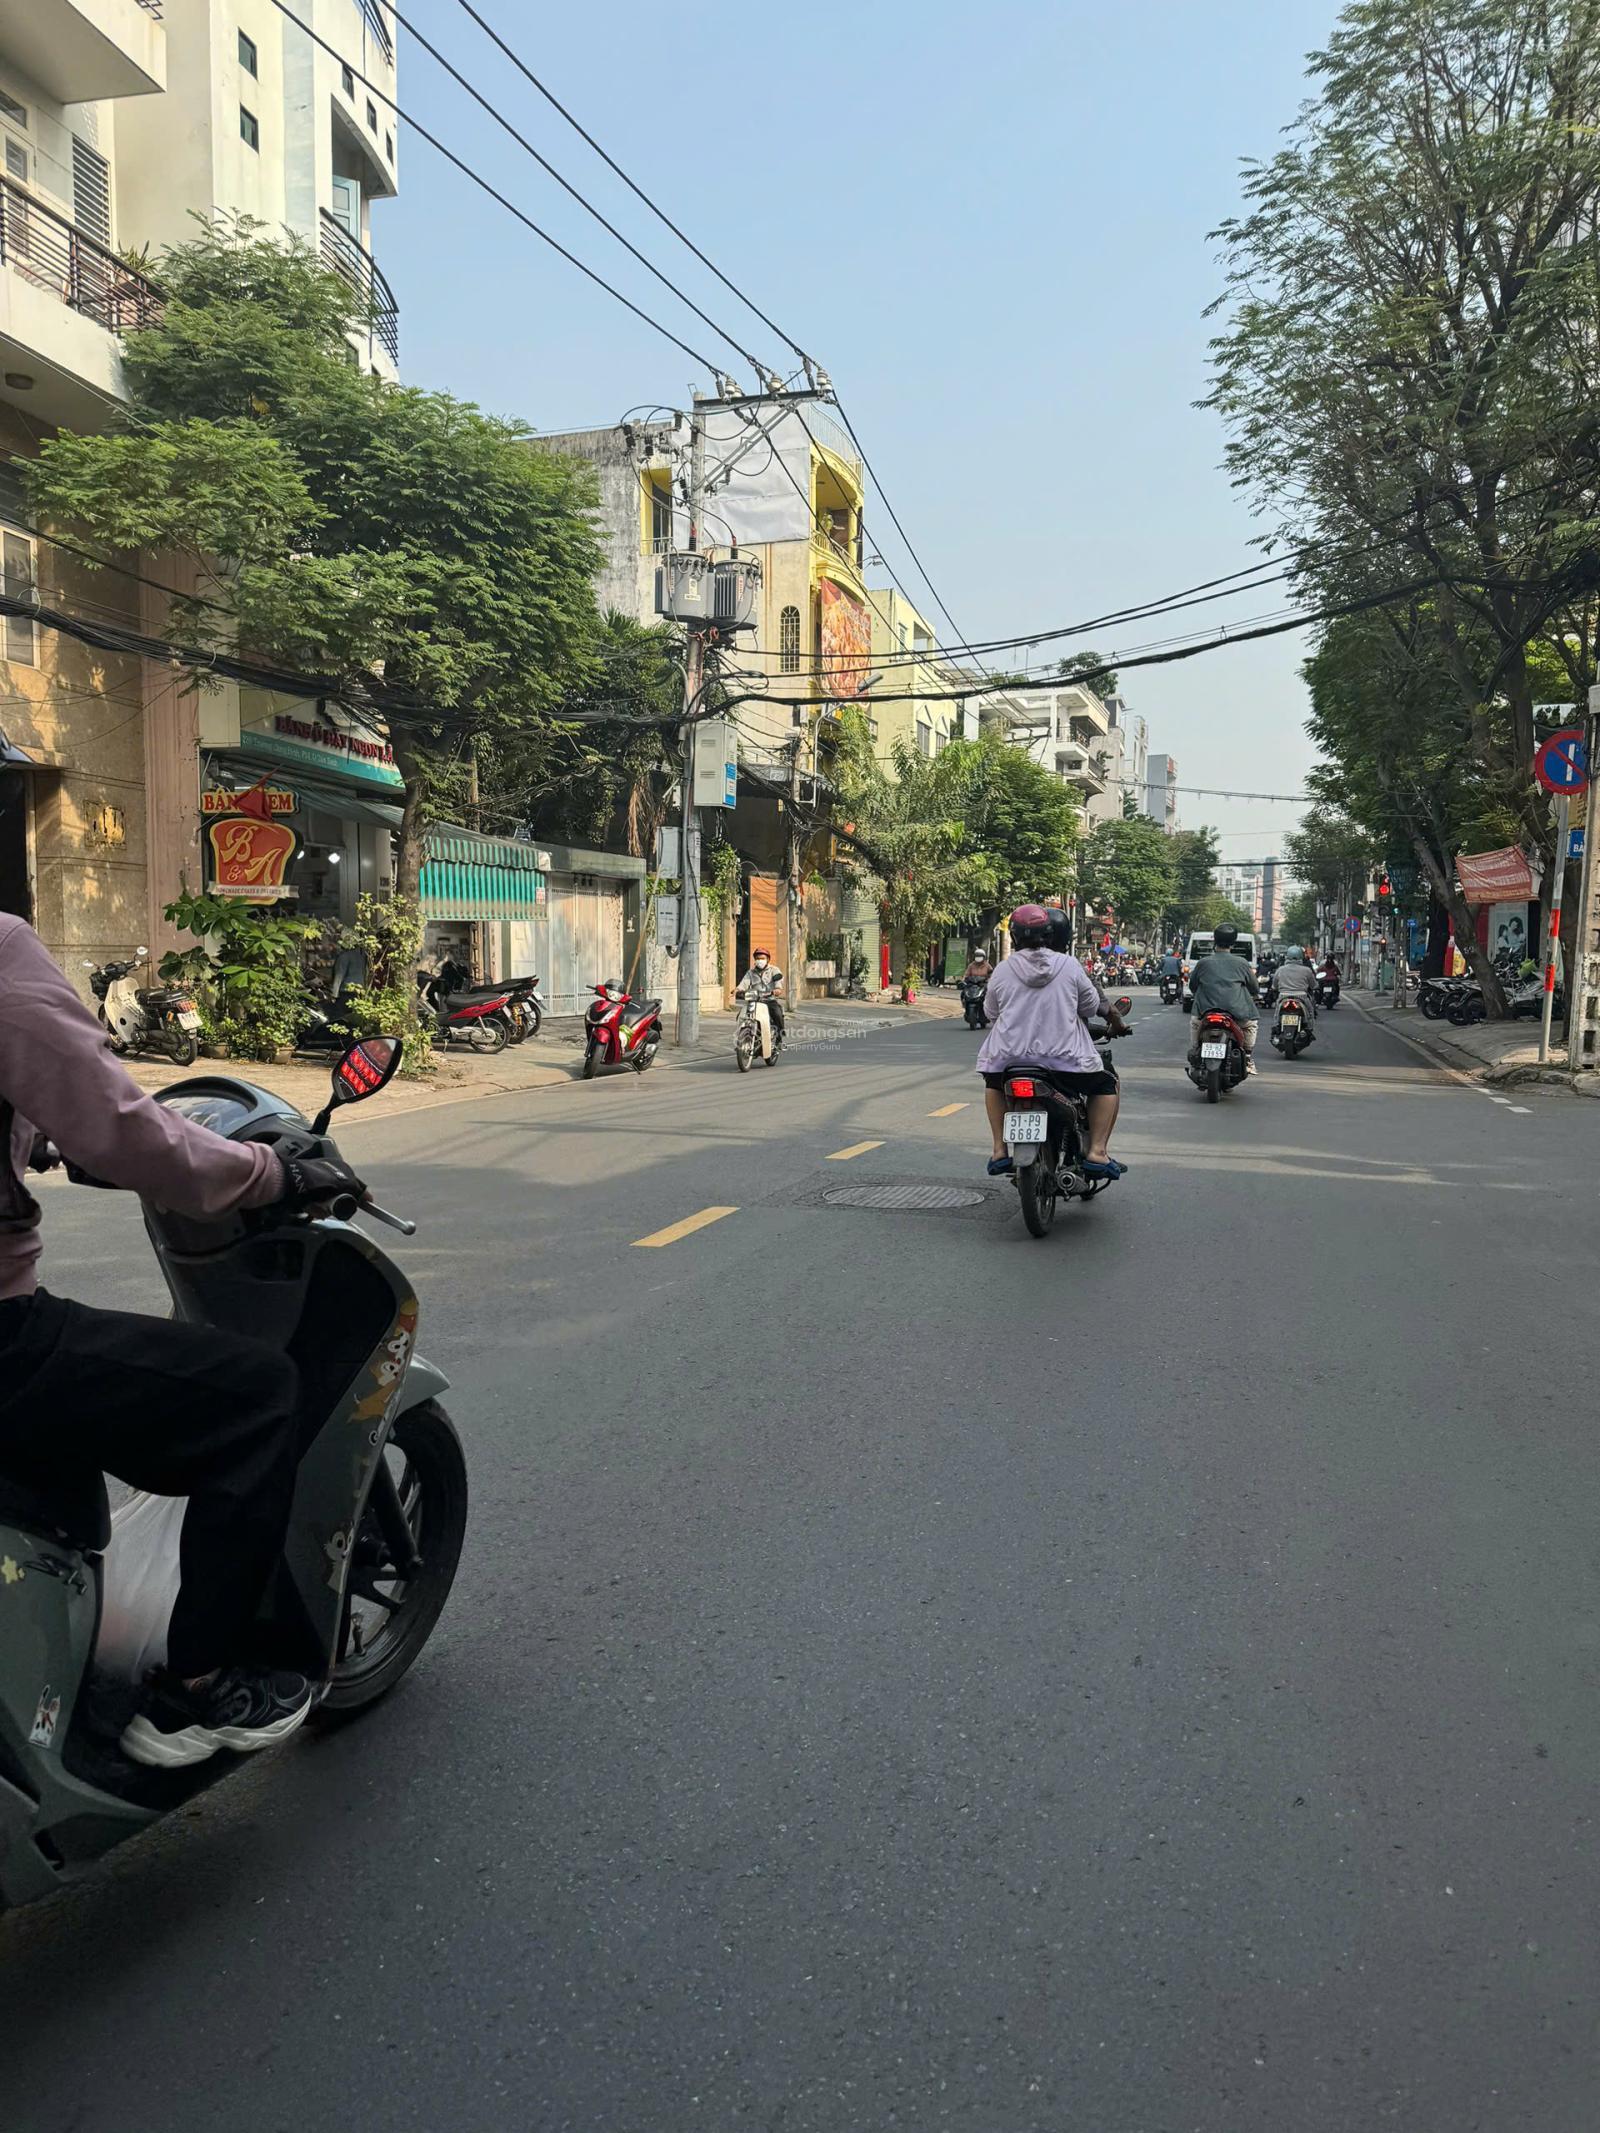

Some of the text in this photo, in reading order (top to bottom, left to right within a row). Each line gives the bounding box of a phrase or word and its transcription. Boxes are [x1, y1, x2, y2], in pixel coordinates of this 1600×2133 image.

[203, 788, 292, 811] BÁN EM
[220, 825, 260, 863] B
[244, 848, 283, 886] A
[1009, 1128, 1041, 1141] 6682
